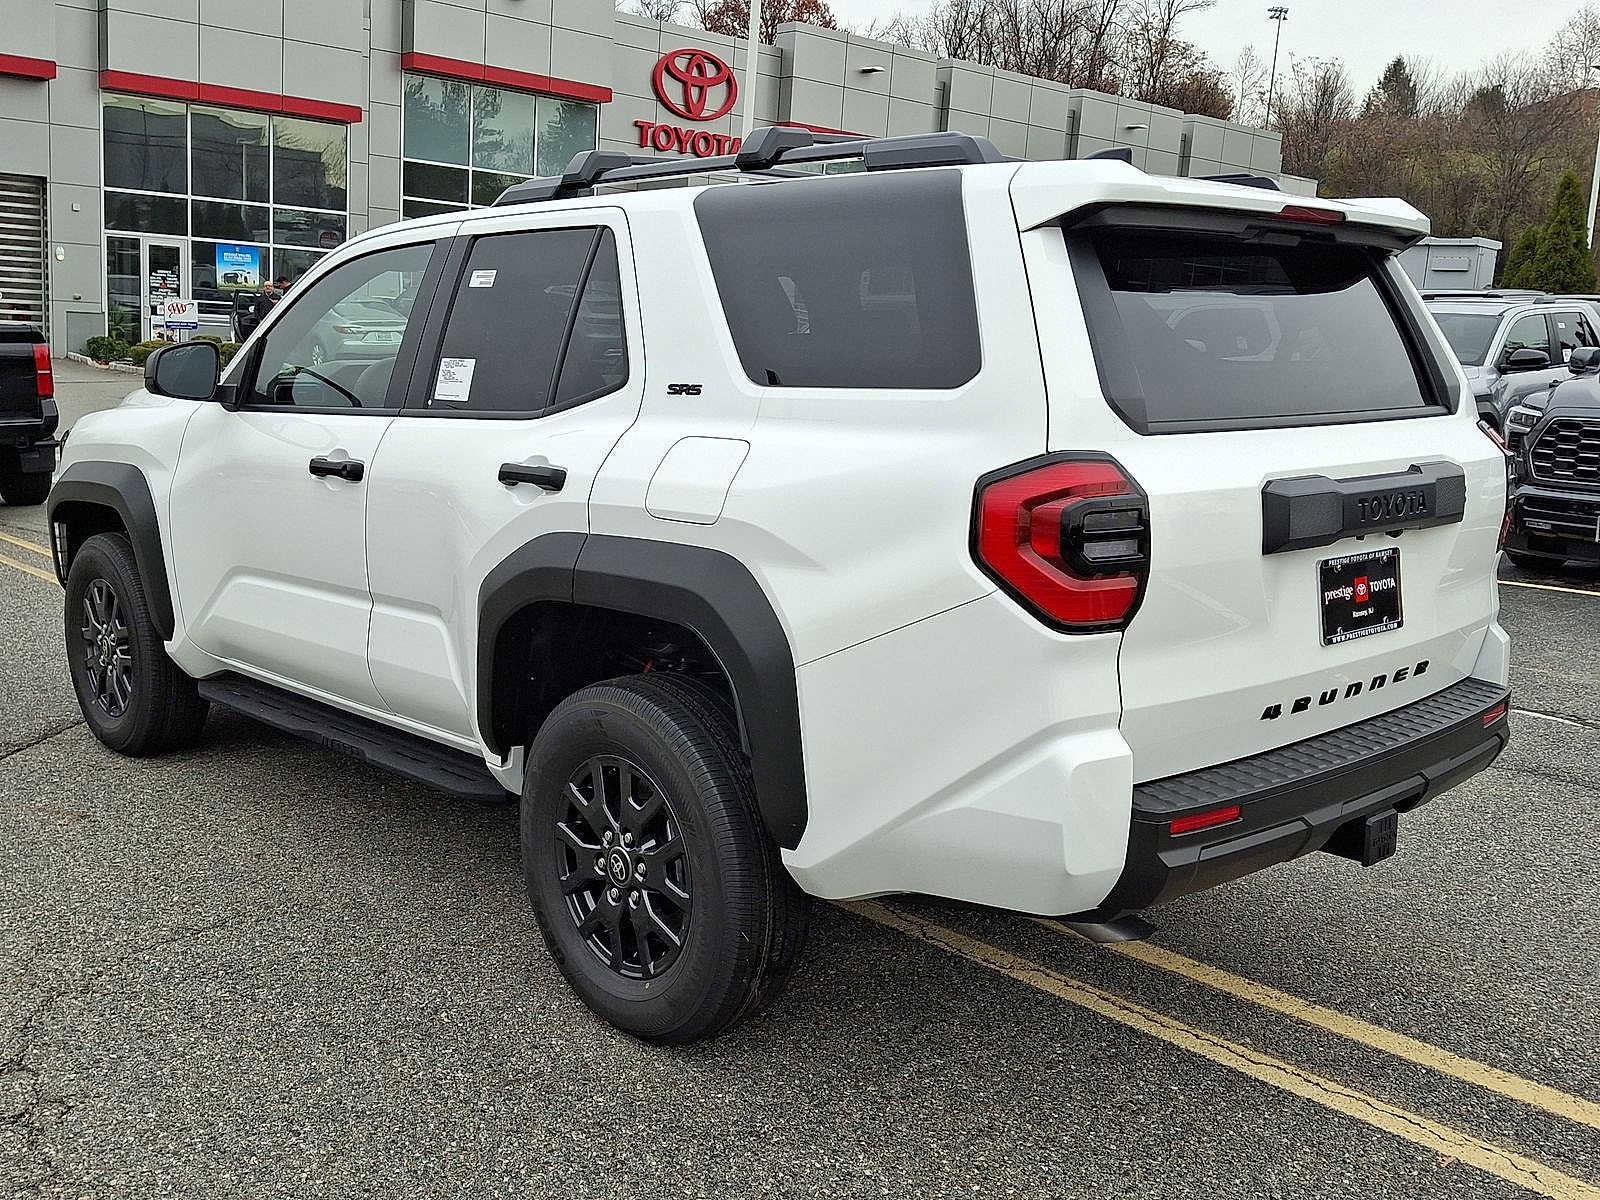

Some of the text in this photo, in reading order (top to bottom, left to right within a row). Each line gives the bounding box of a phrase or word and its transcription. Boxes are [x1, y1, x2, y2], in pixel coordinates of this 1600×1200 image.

[667, 384, 703, 396] SR5
[1358, 490, 1428, 522] TOYOTA
[1328, 558, 1350, 567] PRESTIGE
[1350, 554, 1368, 563] TOYOTA
[1324, 577, 1396, 605] prestige TOYOTA
